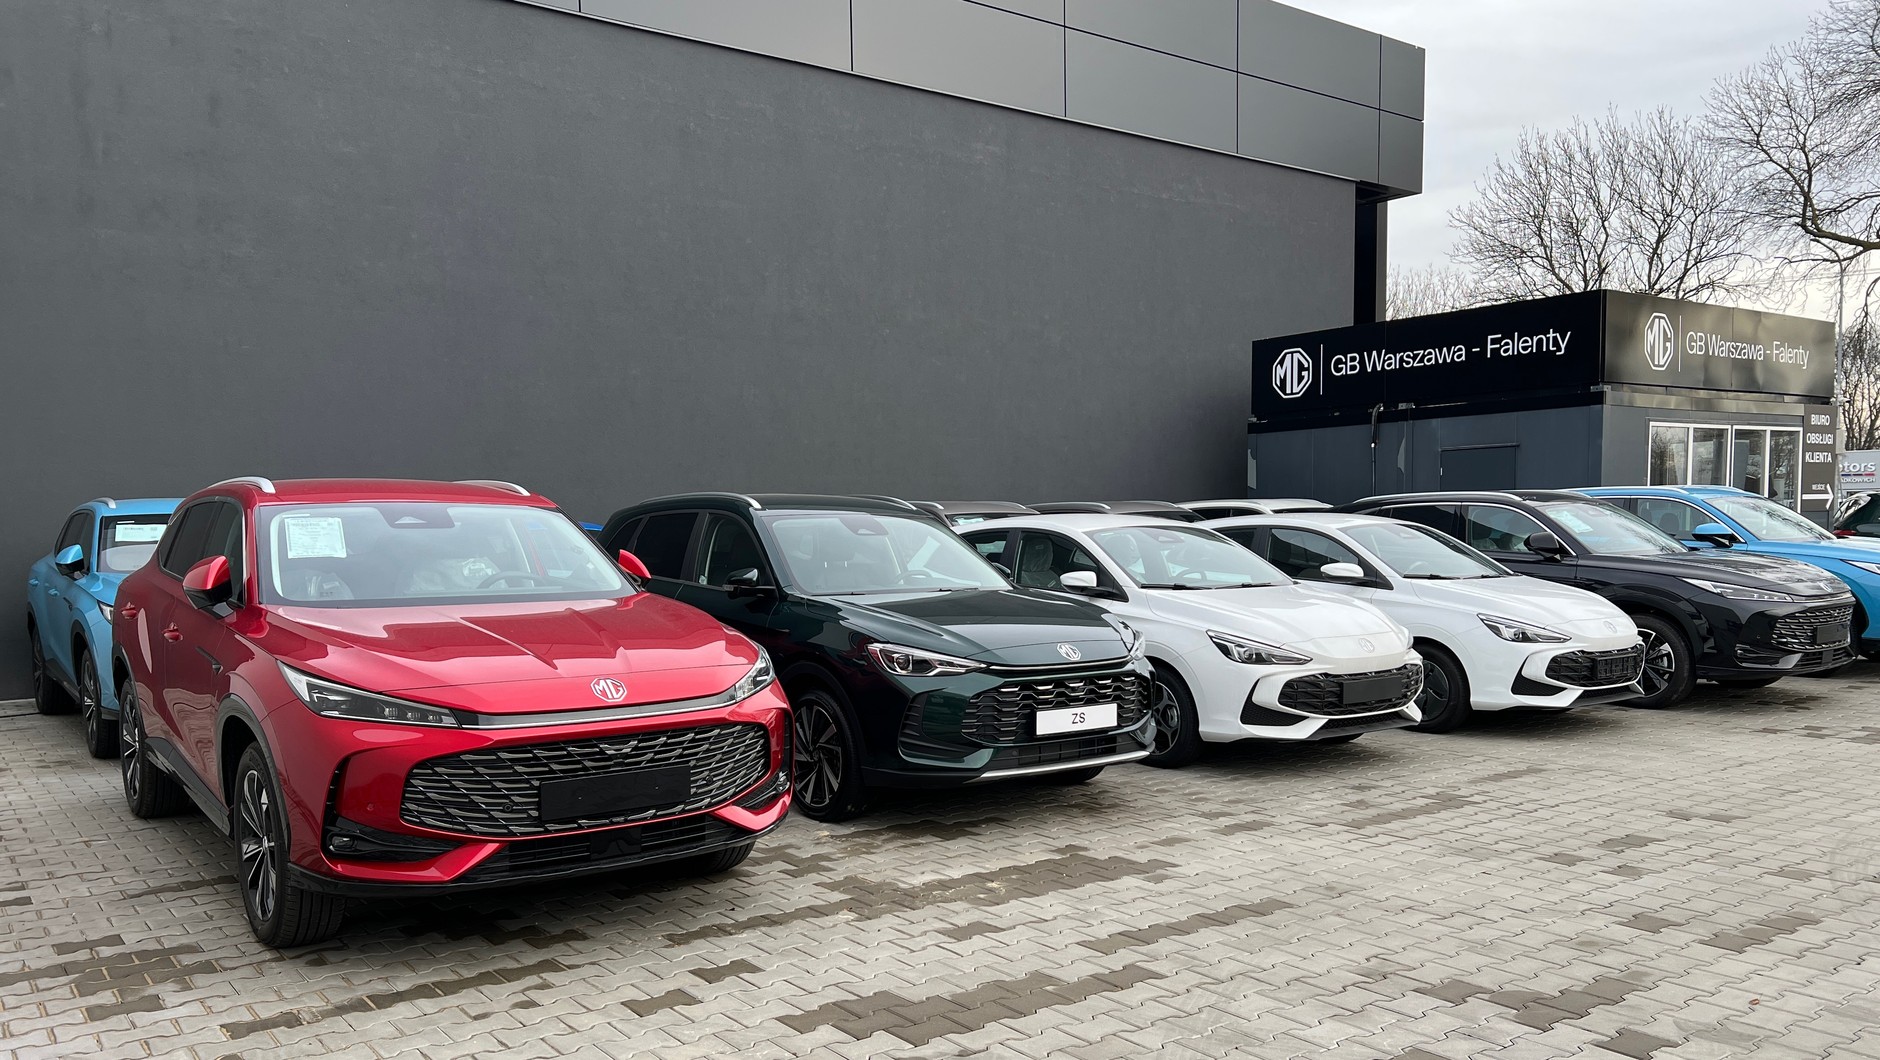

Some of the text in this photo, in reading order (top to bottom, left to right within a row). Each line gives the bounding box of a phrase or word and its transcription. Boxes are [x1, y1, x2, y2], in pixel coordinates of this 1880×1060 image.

[1645, 315, 1673, 368] MG
[1686, 331, 1706, 355] GB
[1707, 333, 1764, 361] Warszawa
[1772, 341, 1810, 370] Falenty
[1330, 353, 1360, 376] GB
[1364, 344, 1466, 373] Warszawa
[1487, 328, 1572, 358] Falenty
[1274, 350, 1311, 396] MG
[1810, 414, 1831, 426] BIURO
[1806, 432, 1834, 445] OBSŁUGI
[1805, 451, 1832, 463] KLIENTA
[1058, 644, 1081, 660] MG
[592, 678, 626, 701] MG
[1071, 712, 1086, 725] ZS
